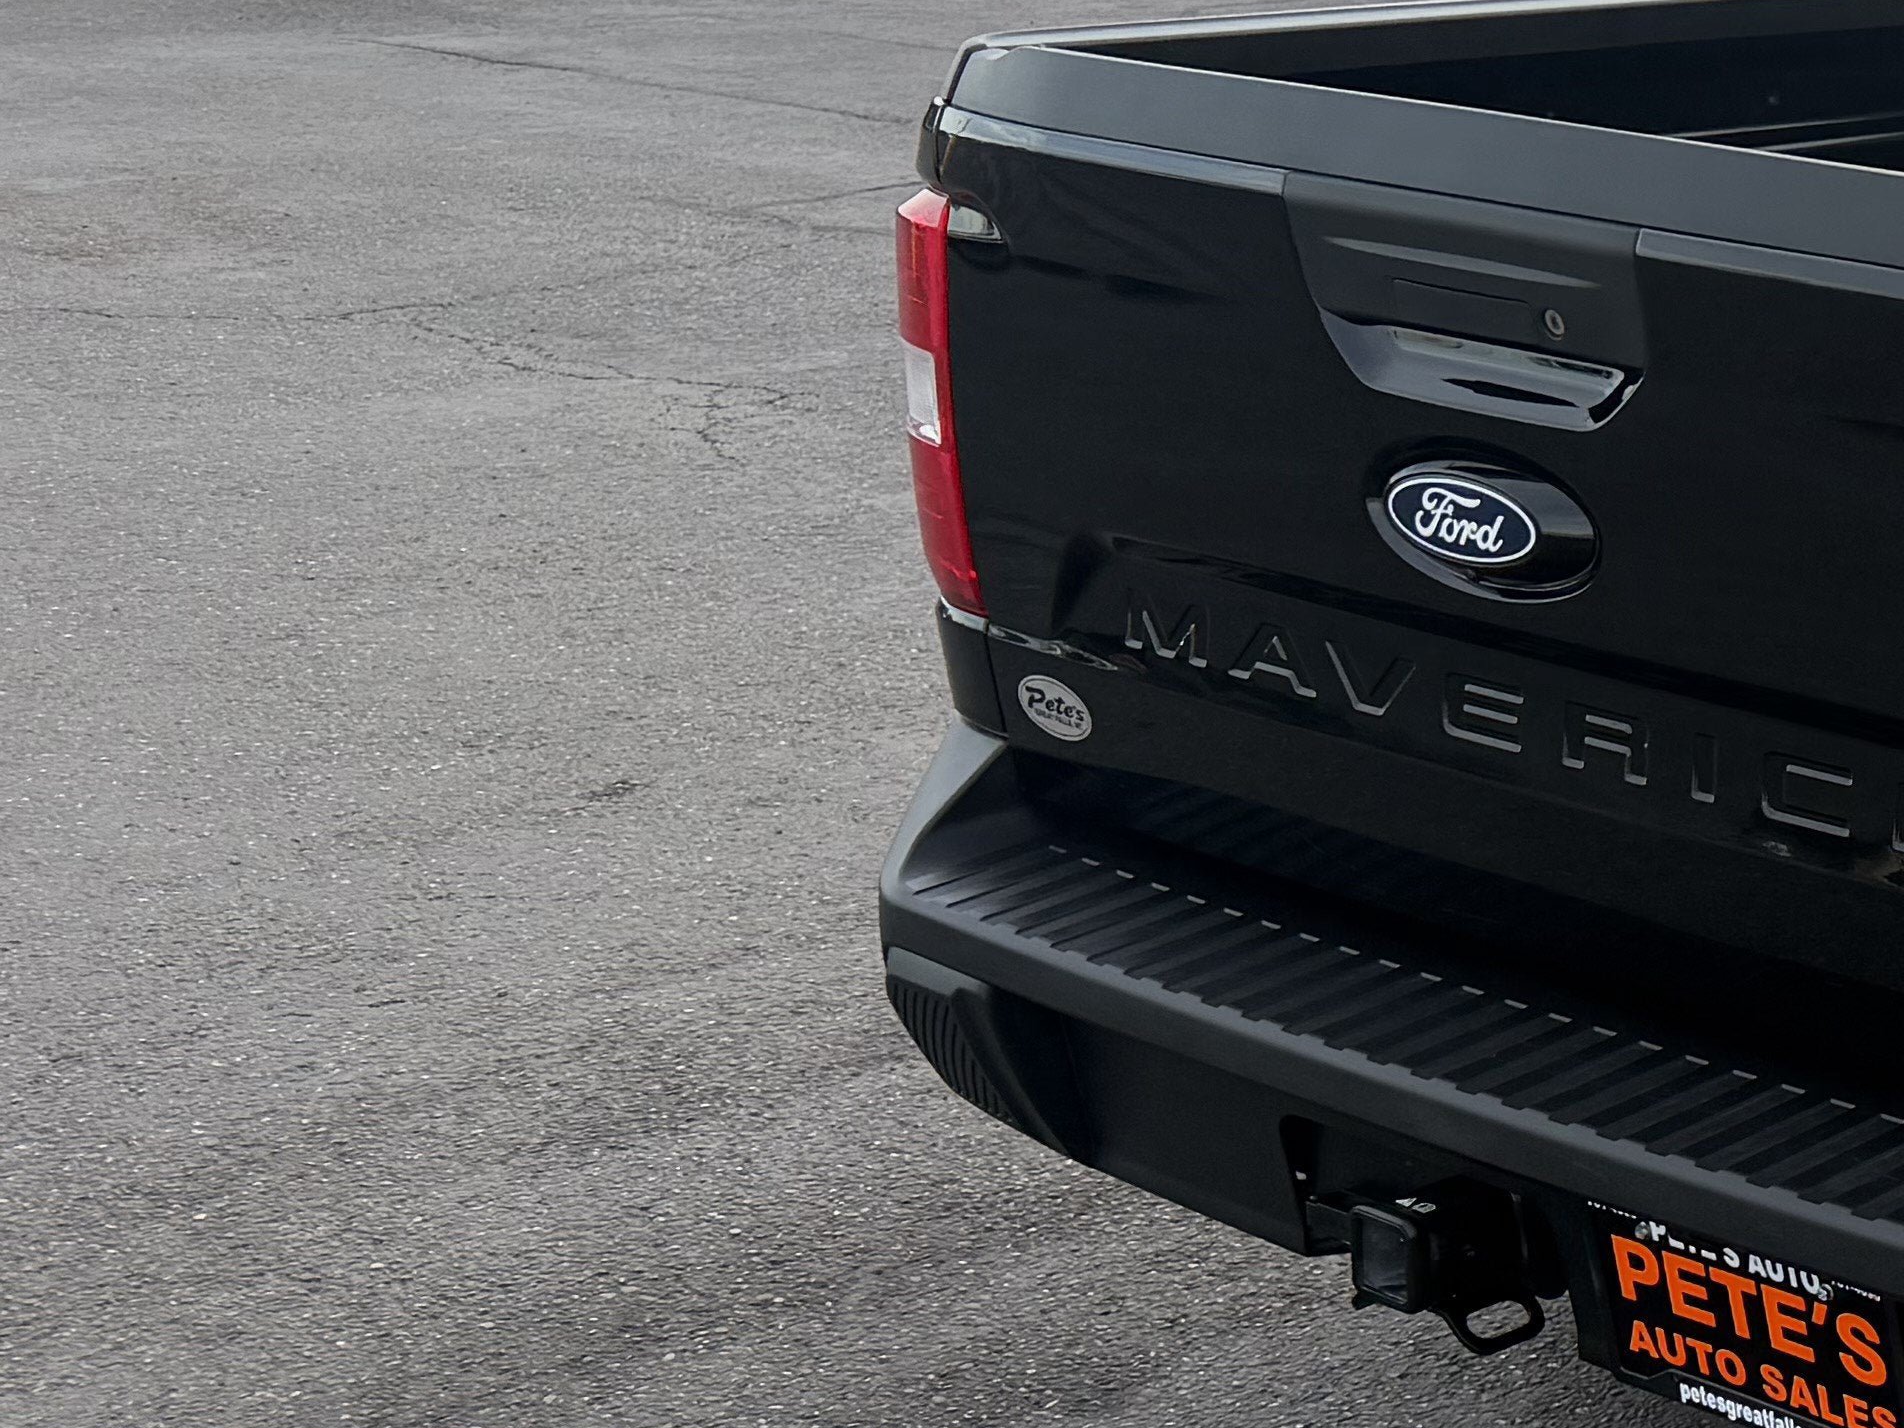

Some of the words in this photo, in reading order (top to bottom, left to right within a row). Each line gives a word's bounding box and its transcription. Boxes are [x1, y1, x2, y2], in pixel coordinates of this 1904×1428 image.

[1414, 486, 1505, 553] Ford
[1610, 1233, 1888, 1387] PETE'S
[1629, 1319, 1747, 1387] AUTO
